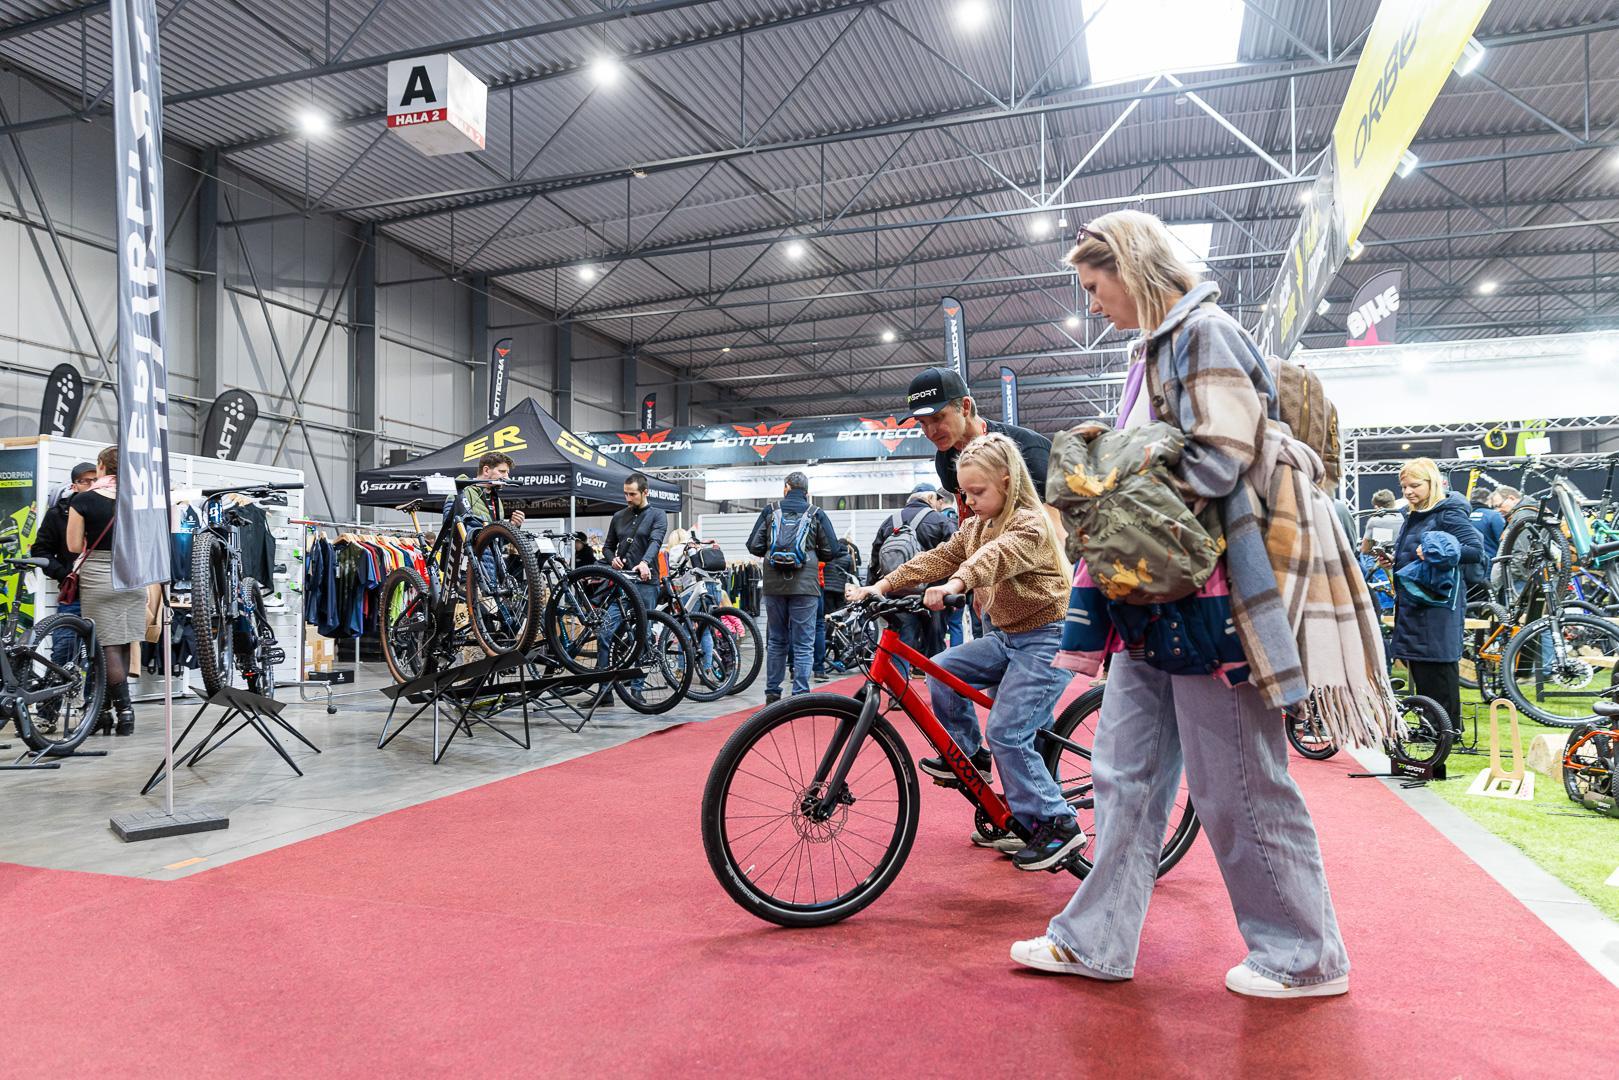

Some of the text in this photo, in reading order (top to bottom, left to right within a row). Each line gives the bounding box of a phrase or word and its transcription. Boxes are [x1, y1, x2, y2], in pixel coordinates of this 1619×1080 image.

[399, 65, 437, 107] A
[1353, 10, 1424, 169] ORBE
[395, 110, 440, 126] HALA 2
[493, 358, 504, 417] BOTTECCHIA
[463, 425, 526, 458] ER
[597, 440, 693, 455] BOTTECCHIA
[712, 432, 814, 448] BOTTECCHIA
[369, 481, 411, 492] SCOTT
[518, 474, 566, 486] REPUBLIC
[582, 478, 608, 489] SCOTT
